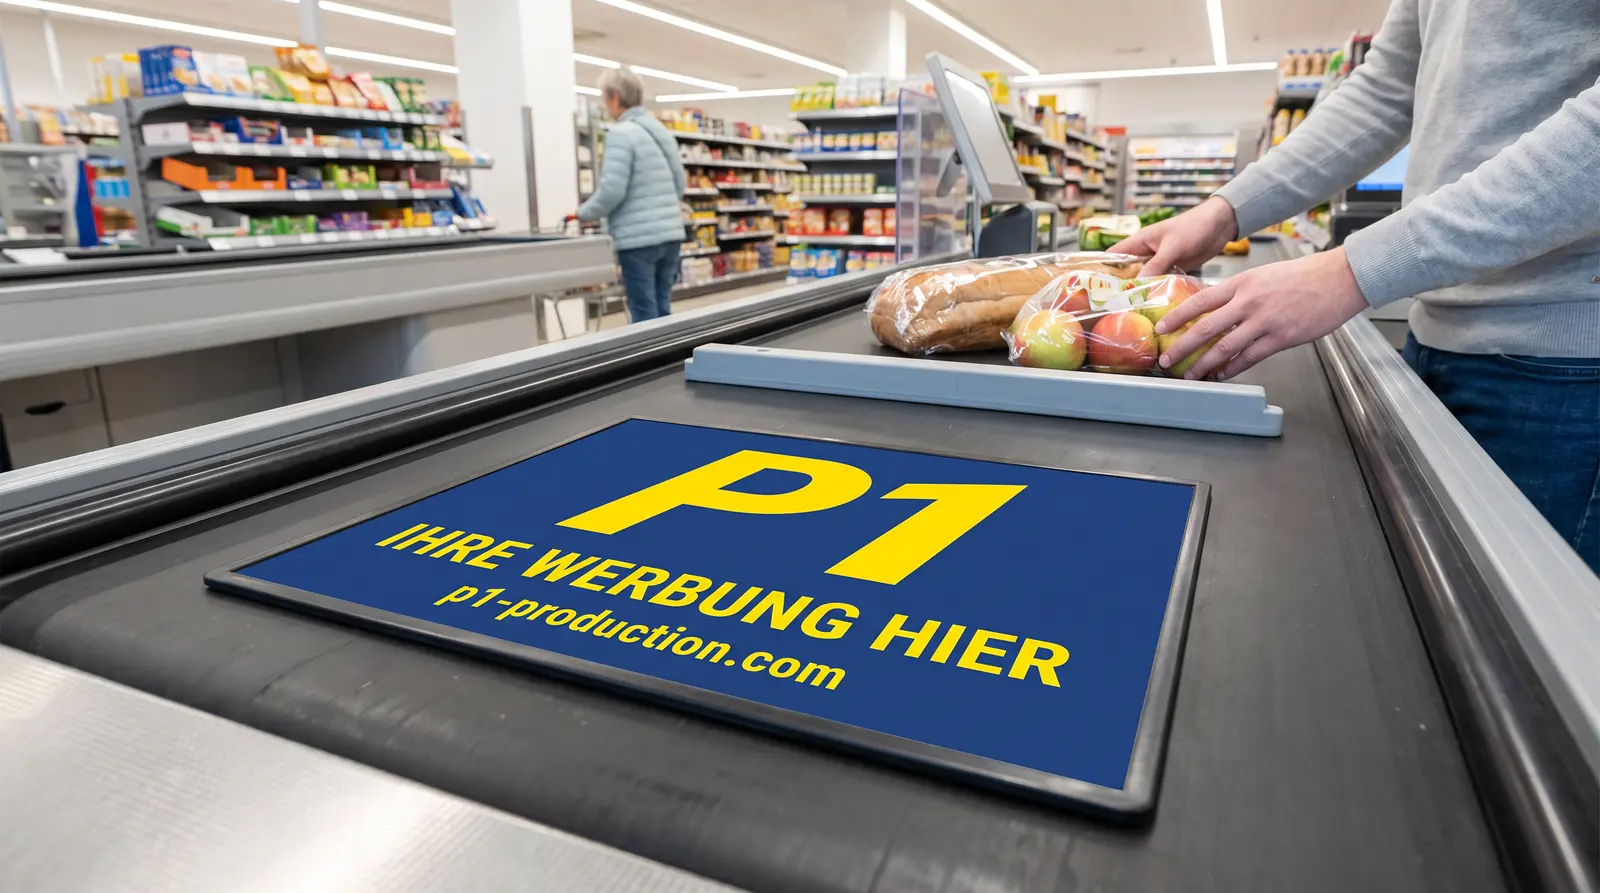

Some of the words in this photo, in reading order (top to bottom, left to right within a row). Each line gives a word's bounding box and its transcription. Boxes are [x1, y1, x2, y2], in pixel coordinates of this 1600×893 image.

[556, 449, 1027, 586] P1
[376, 523, 533, 571] IHRE
[521, 548, 861, 640] WERBUNG
[869, 613, 1071, 688] HIER
[435, 585, 846, 691] p1-production.com
